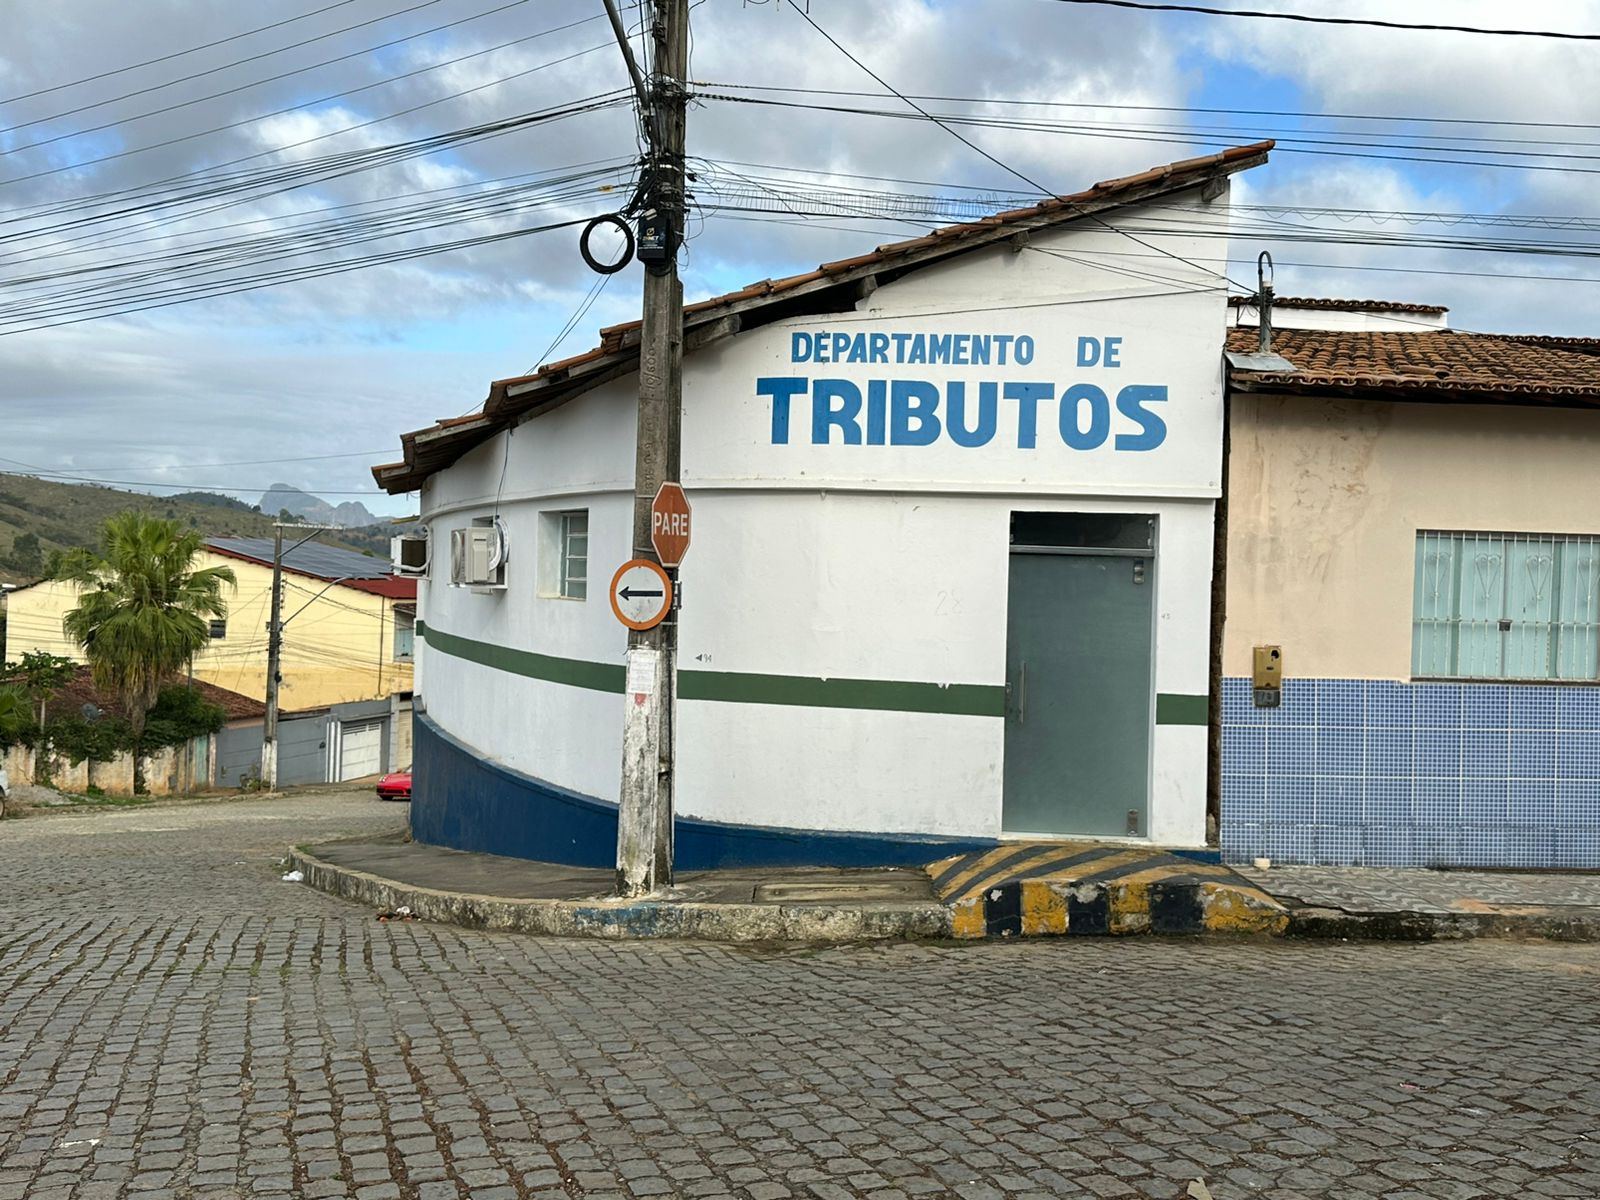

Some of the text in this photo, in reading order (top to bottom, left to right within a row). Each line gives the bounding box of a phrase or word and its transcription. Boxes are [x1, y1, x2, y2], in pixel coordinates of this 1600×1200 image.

[791, 332, 1123, 368] DEPARTAMENTO DE
[756, 377, 1169, 451] TRIBUTOS
[653, 511, 689, 537] PARE
